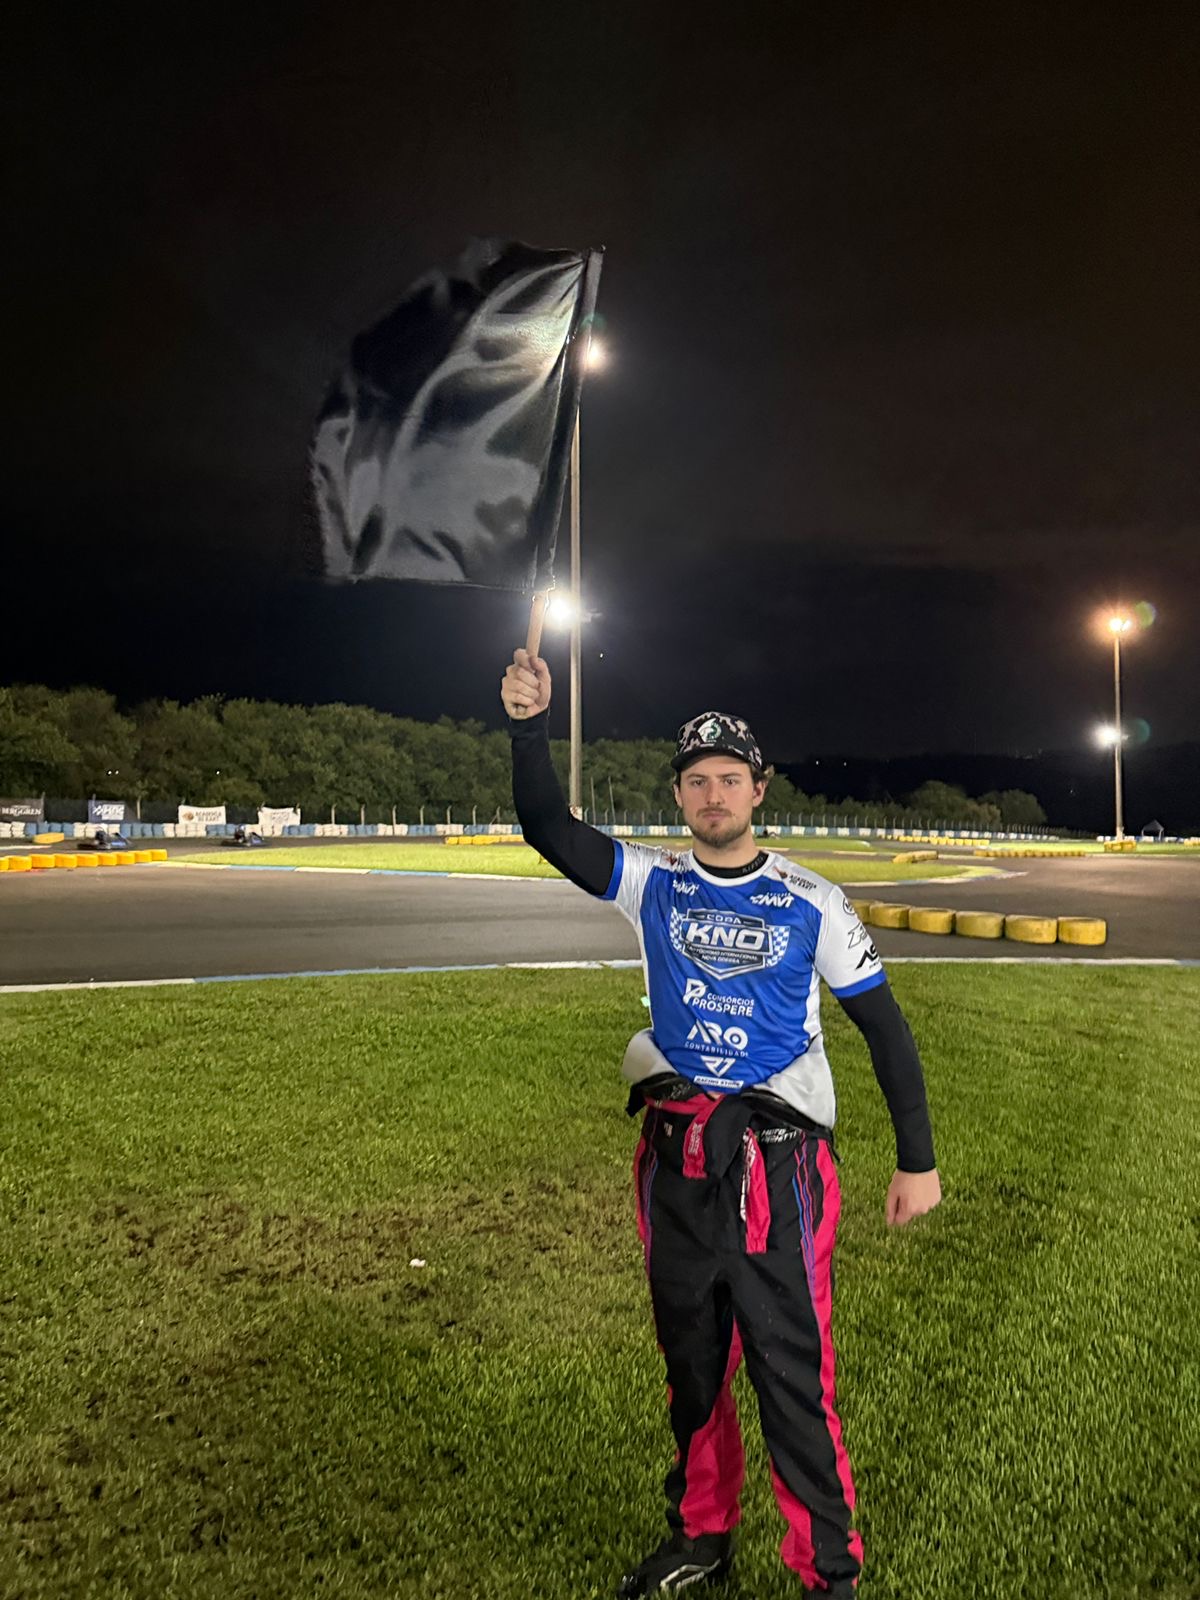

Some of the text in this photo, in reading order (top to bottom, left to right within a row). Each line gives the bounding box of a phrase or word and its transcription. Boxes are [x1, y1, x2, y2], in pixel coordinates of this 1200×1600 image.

[706, 913, 742, 925] COPA
[686, 922, 766, 951] KNO
[692, 997, 754, 1018] PROSPERE
[707, 993, 755, 1007] CONSÓRCIOS
